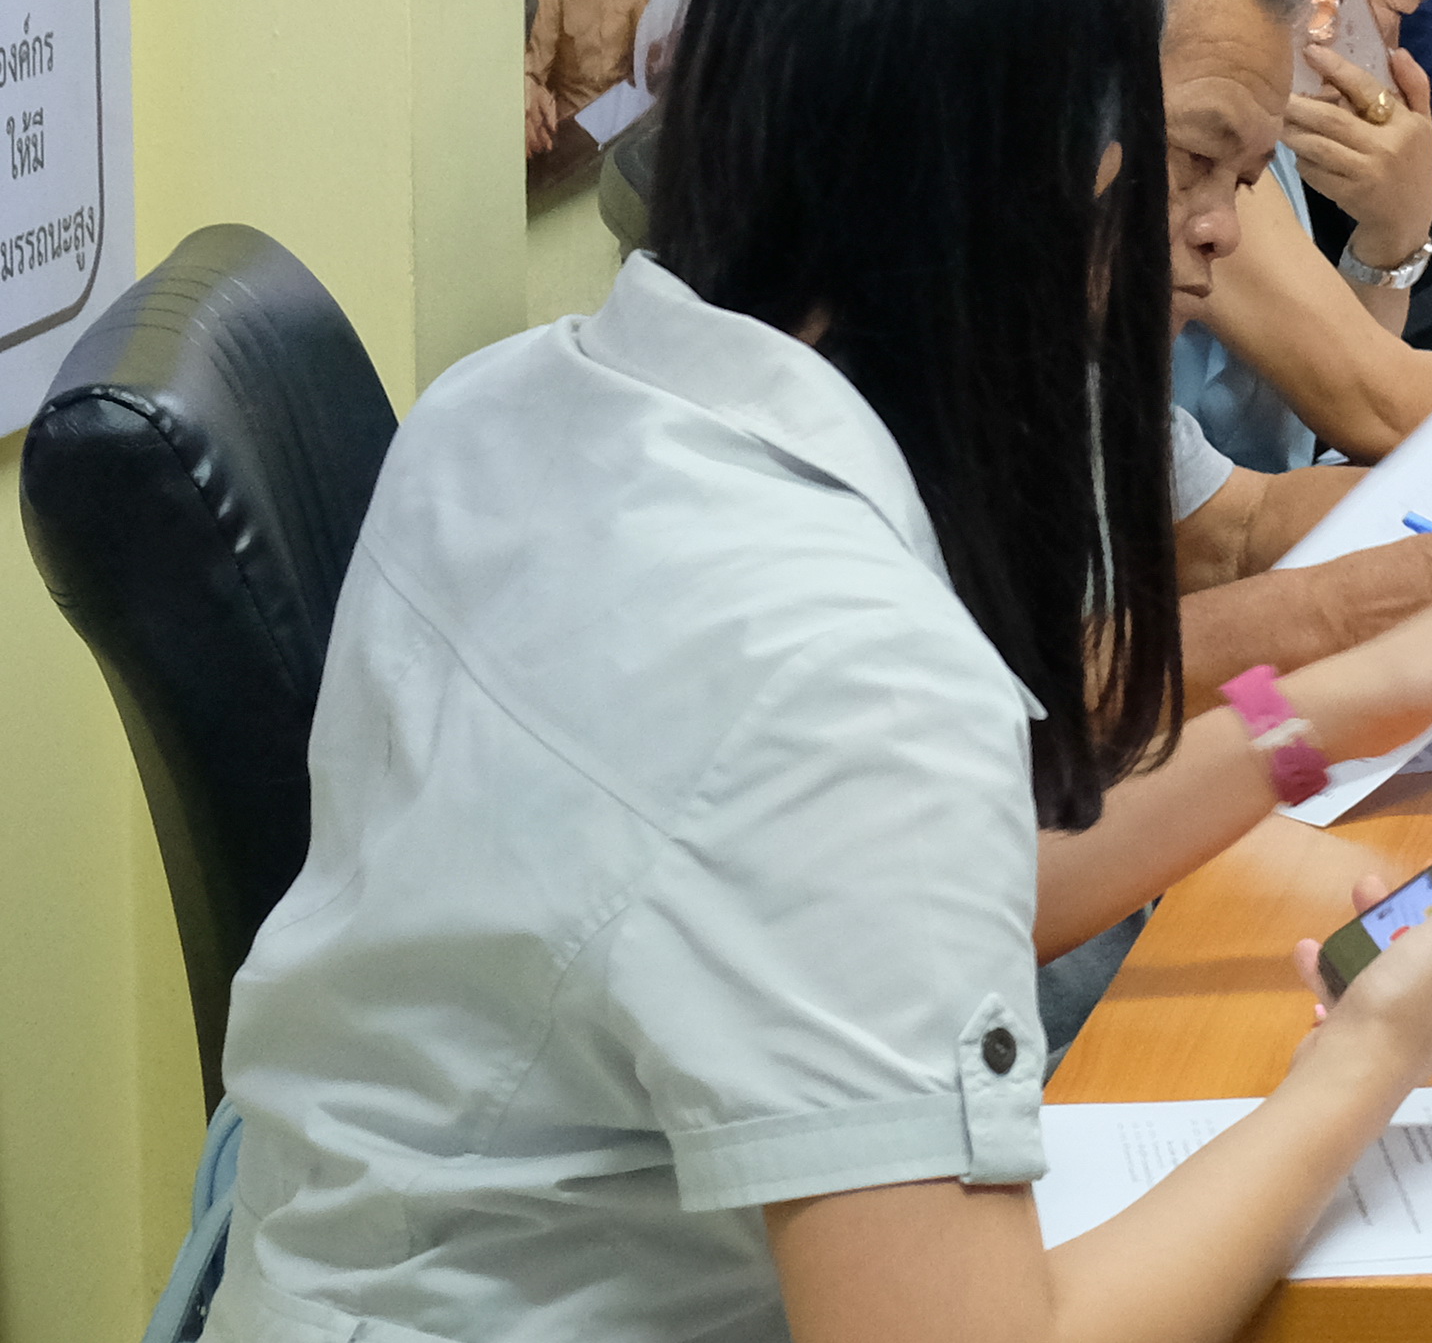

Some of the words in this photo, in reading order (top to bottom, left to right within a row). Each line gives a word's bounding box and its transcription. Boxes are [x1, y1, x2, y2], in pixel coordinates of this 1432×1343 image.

[6, 107, 45, 180] ให้มี
[0, 206, 95, 282] มรรถนะสูง
